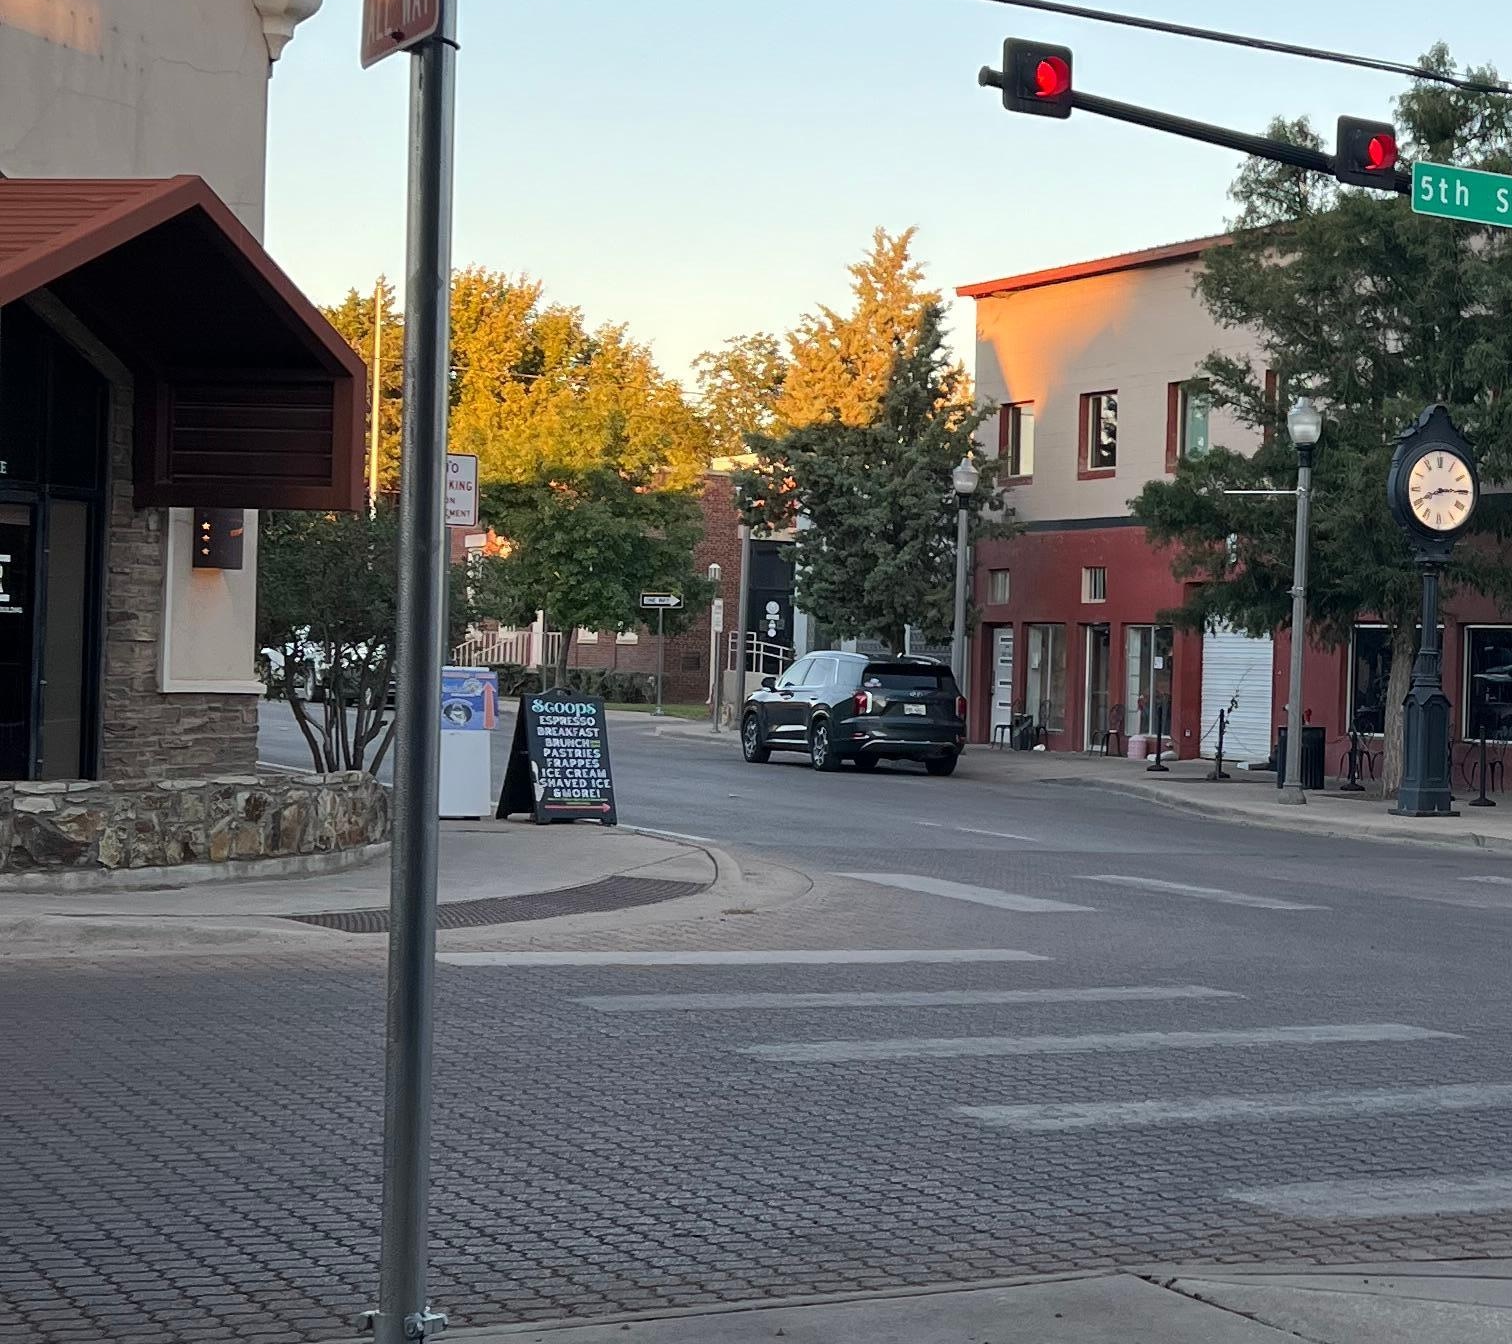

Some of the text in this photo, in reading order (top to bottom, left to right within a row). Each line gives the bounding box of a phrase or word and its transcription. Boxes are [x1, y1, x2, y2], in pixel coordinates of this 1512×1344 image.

[1420, 175, 1469, 207] 5th
[448, 479, 473, 492] KING
[539, 716, 595, 726] ESPRESSO
[537, 727, 600, 737] BREAKFAST
[545, 738, 589, 748] BRUNCH
[543, 748, 601, 758] PASTRIES
[547, 759, 600, 768] FRAPPES
[541, 769, 607, 778] ICE CREAM
[540, 779, 611, 788] SHAVED ICE
